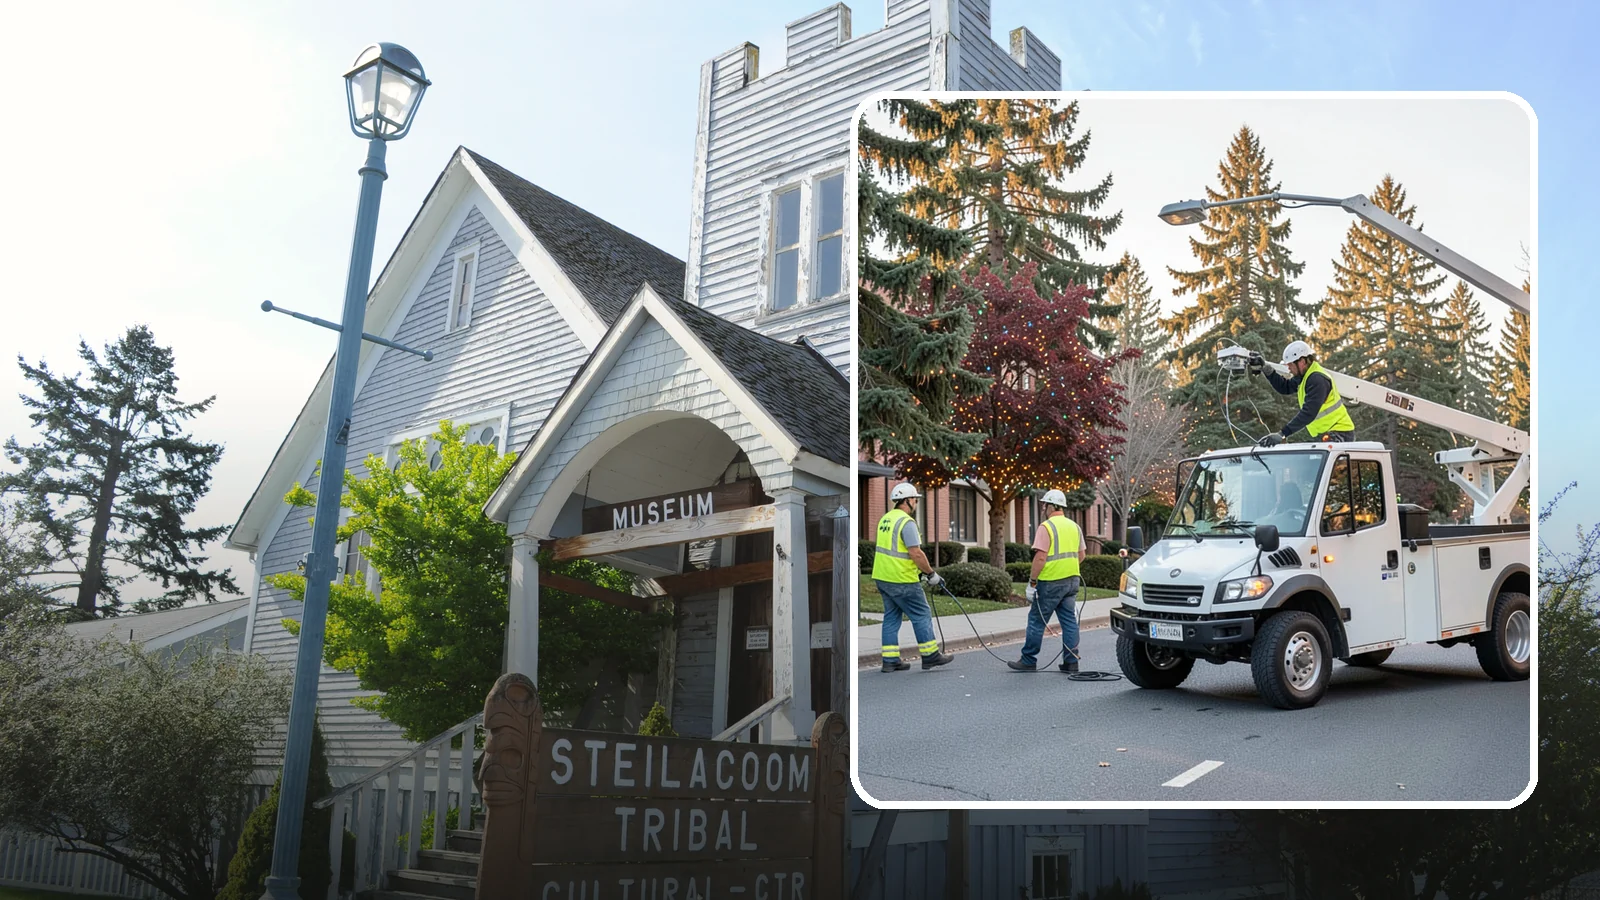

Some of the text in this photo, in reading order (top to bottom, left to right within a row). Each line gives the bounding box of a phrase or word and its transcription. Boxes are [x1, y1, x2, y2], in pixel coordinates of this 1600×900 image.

[613, 491, 713, 530] MUSEUM
[551, 738, 809, 793] STEILACOOM
[615, 807, 757, 852] TRIBAL
